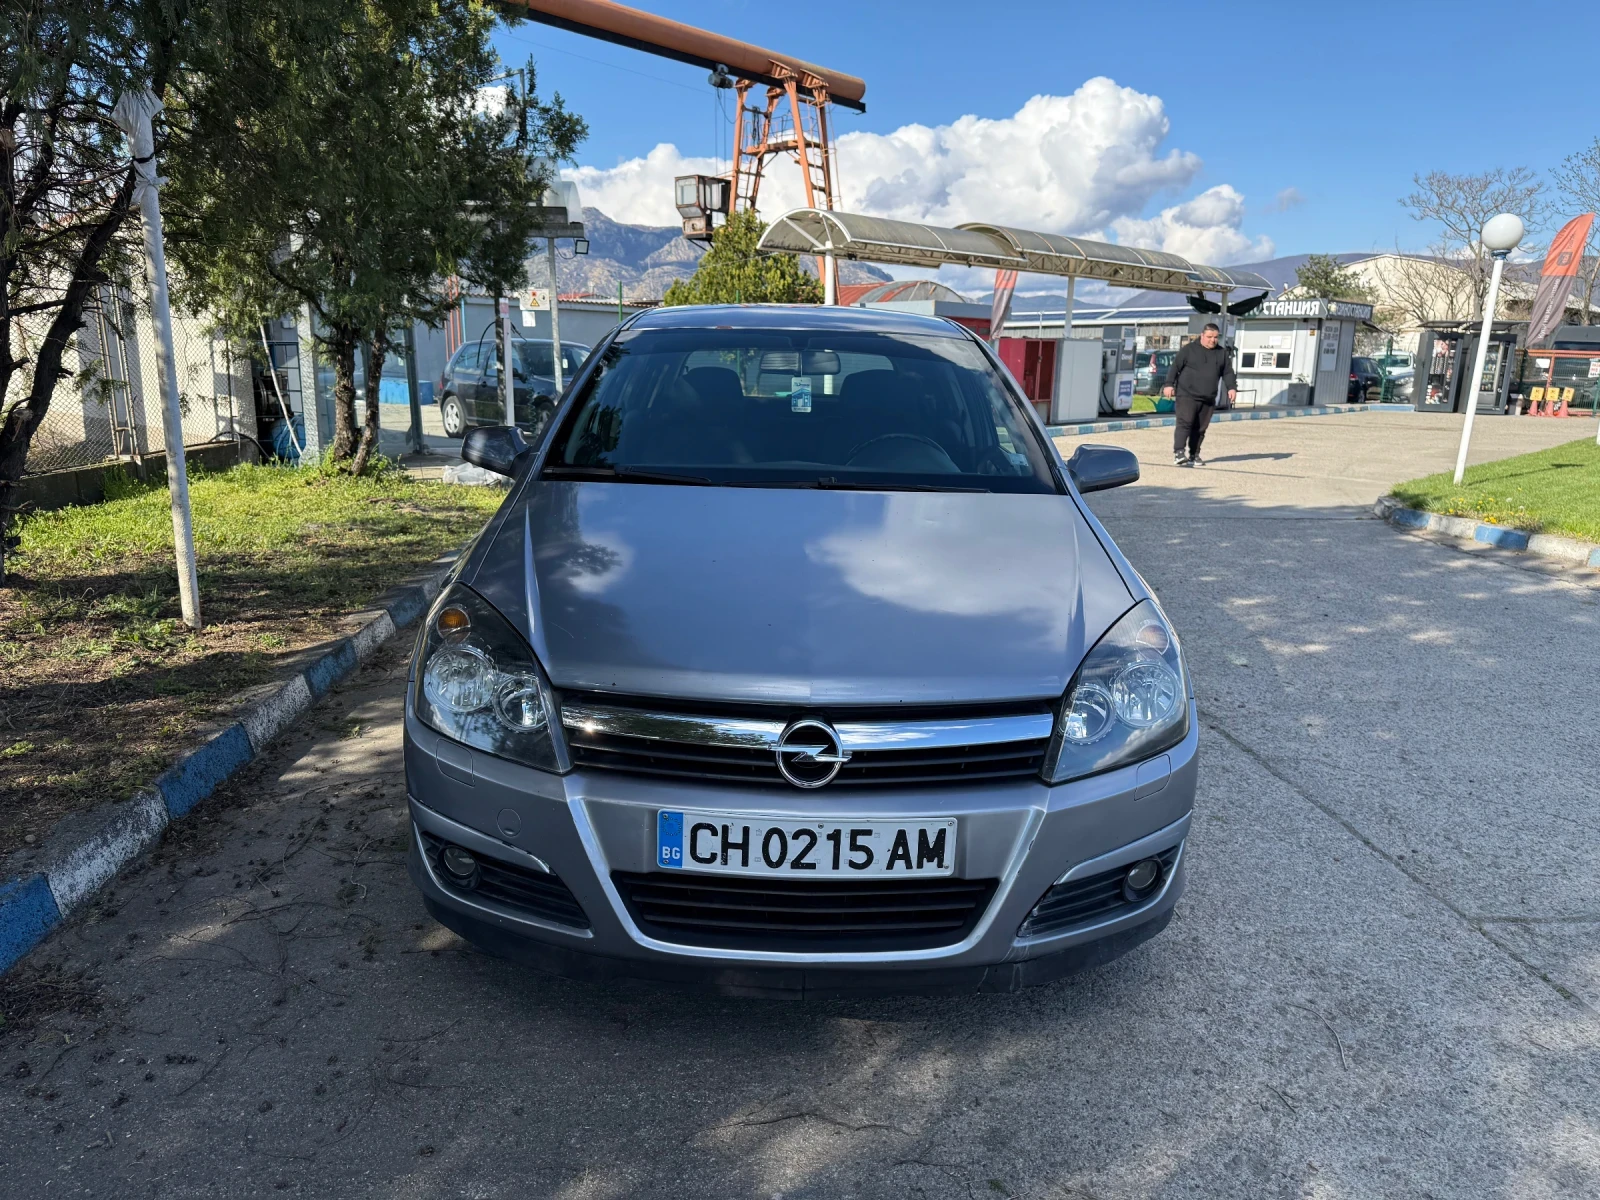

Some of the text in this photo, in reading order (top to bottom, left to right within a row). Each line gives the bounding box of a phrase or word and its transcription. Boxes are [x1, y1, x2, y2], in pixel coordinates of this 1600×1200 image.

[662, 846, 681, 860] BG
[690, 822, 947, 870] CH 0215 AM
